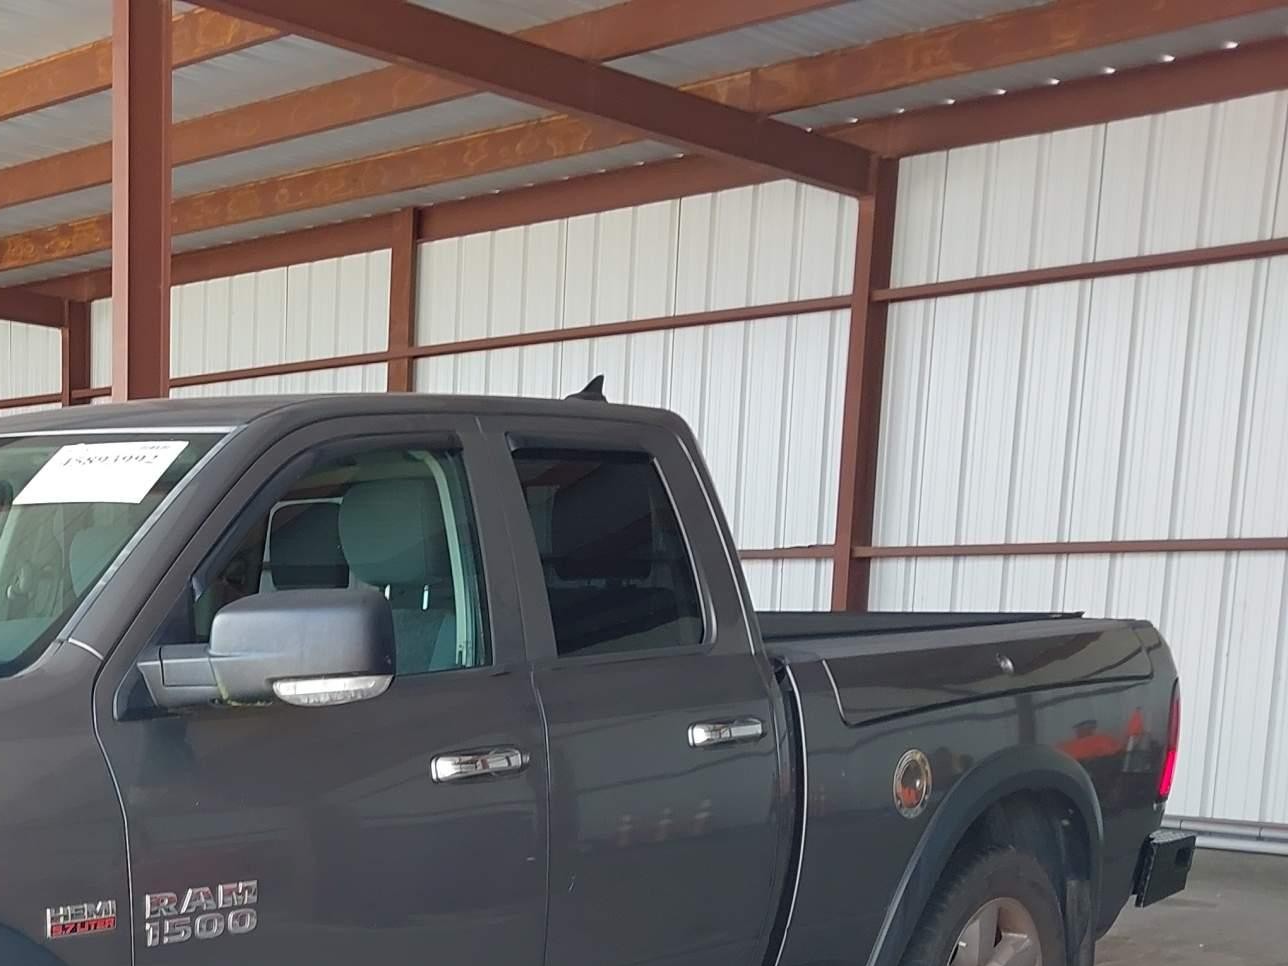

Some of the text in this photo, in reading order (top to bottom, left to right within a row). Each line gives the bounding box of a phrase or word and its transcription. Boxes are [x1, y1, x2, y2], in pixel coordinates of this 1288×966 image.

[46, 900, 116, 925] HEMI
[145, 880, 258, 919] RAM
[145, 908, 257, 947] 1500
